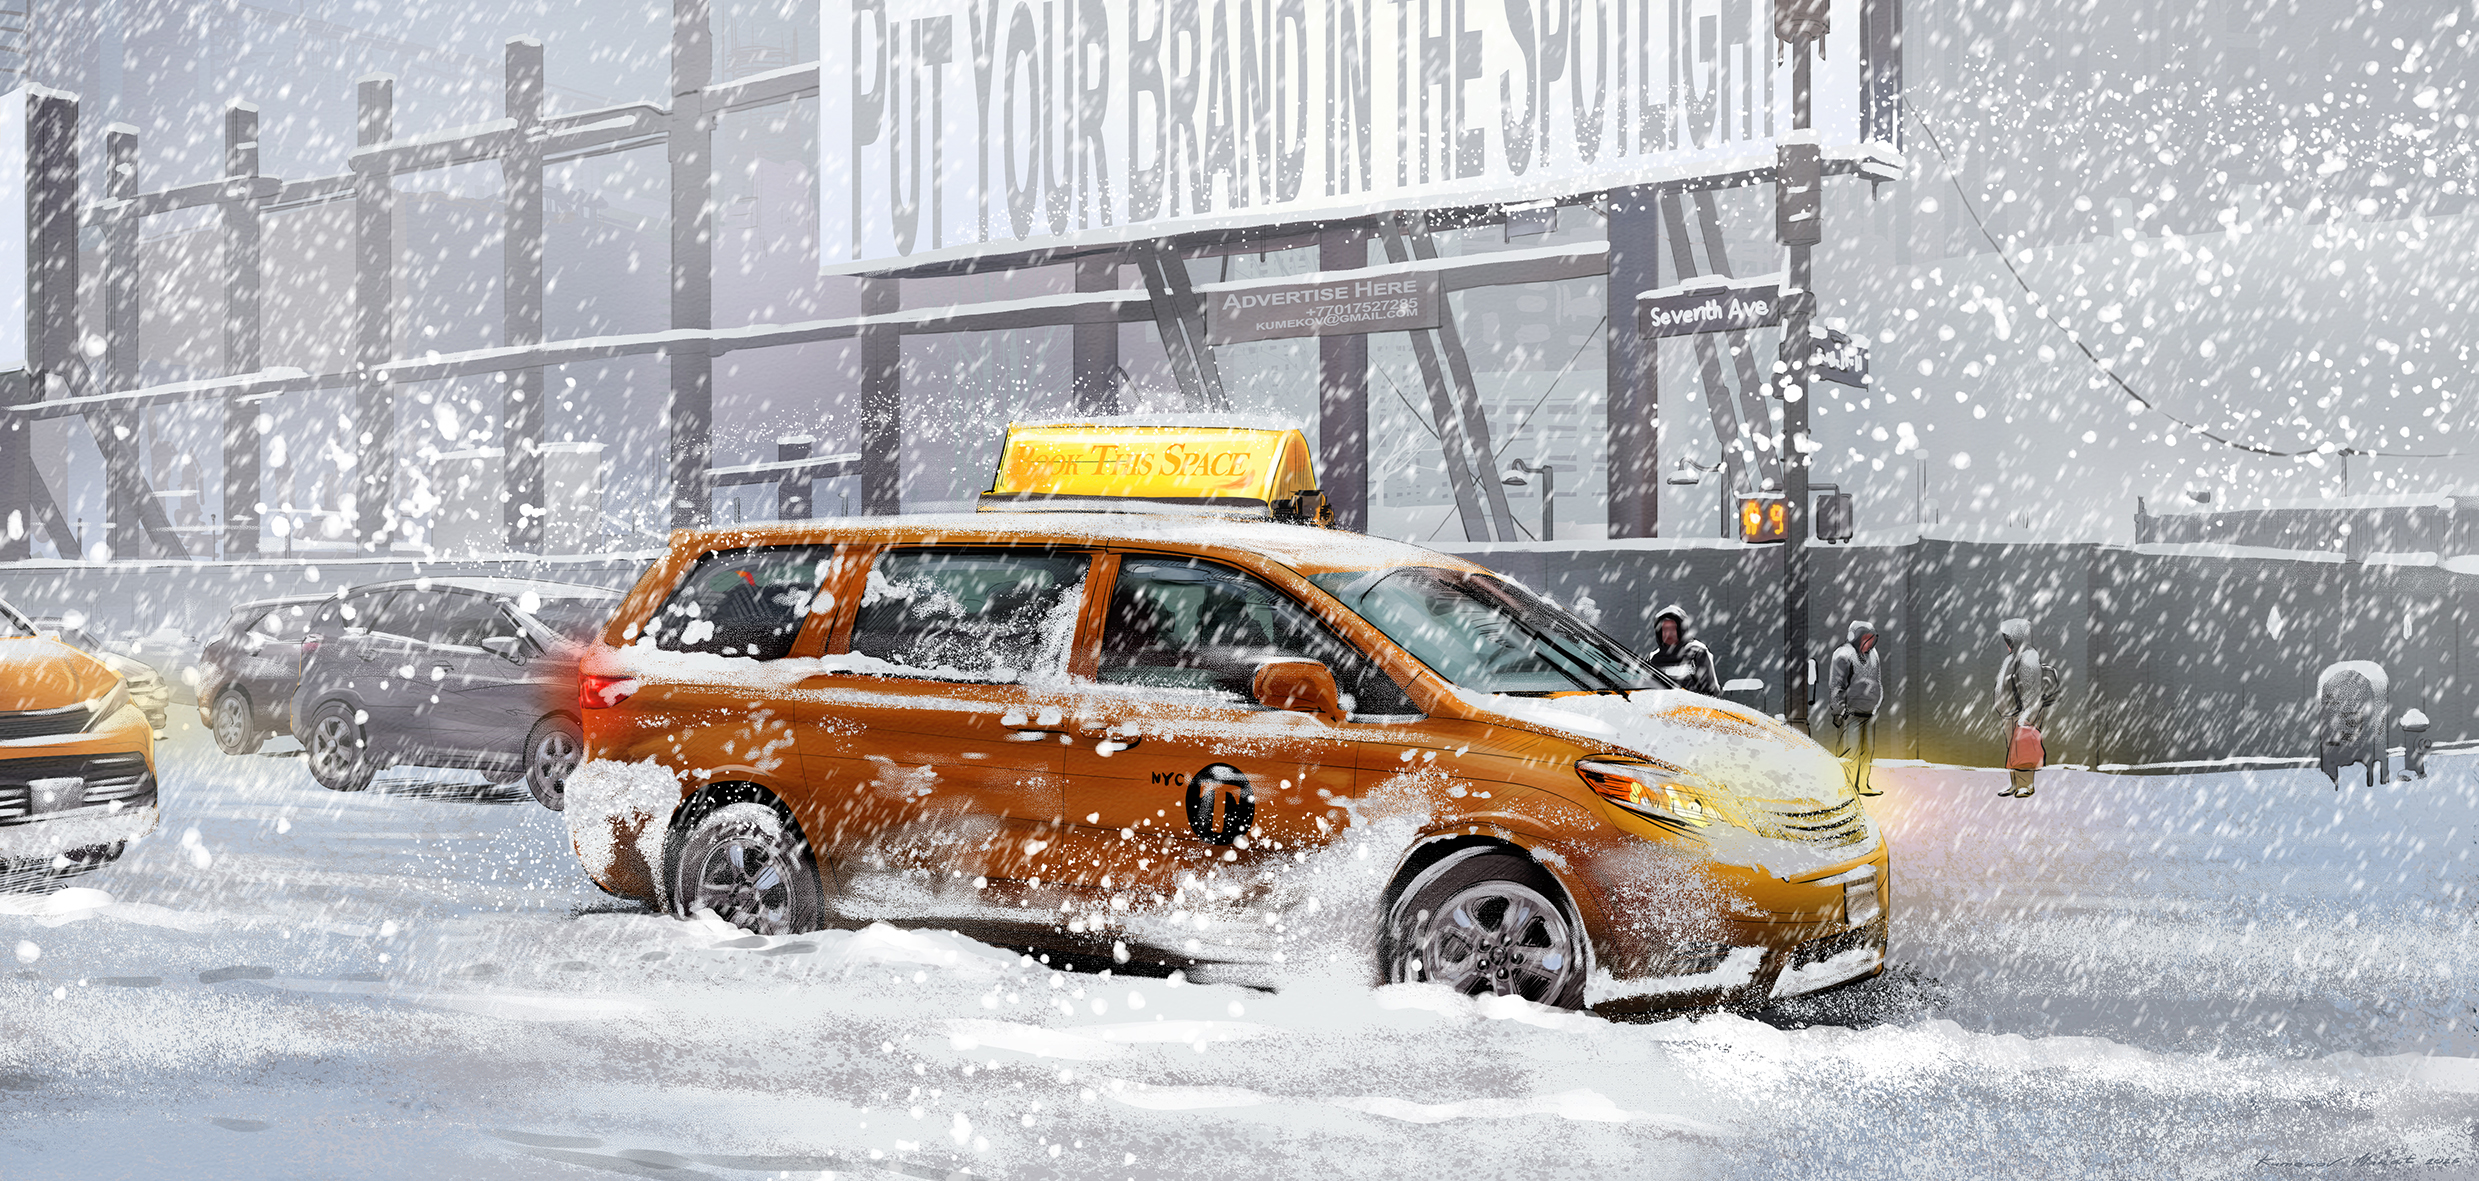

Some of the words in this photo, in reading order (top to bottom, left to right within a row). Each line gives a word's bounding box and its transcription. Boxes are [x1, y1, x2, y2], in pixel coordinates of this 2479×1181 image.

[851, 0, 953, 261] PUT
[967, 0, 1113, 243] YOUR
[1128, 0, 1308, 224] BRAND
[1325, 0, 1372, 198] IN
[1387, 0, 1485, 188] THE
[1222, 286, 1348, 310] ADVERTISE
[1354, 280, 1417, 298] HERE
[1306, 298, 1418, 318] +77017527285
[1255, 308, 1418, 331] KUMEKOV@GMAIL.COM
[1650, 299, 1722, 327] Seventh
[1728, 299, 1769, 319] Ave
[1016, 446, 1083, 477] BOOK
[1090, 444, 1155, 477] THIS
[1157, 442, 1251, 477] SPACE
[1151, 771, 1184, 787] NYC
